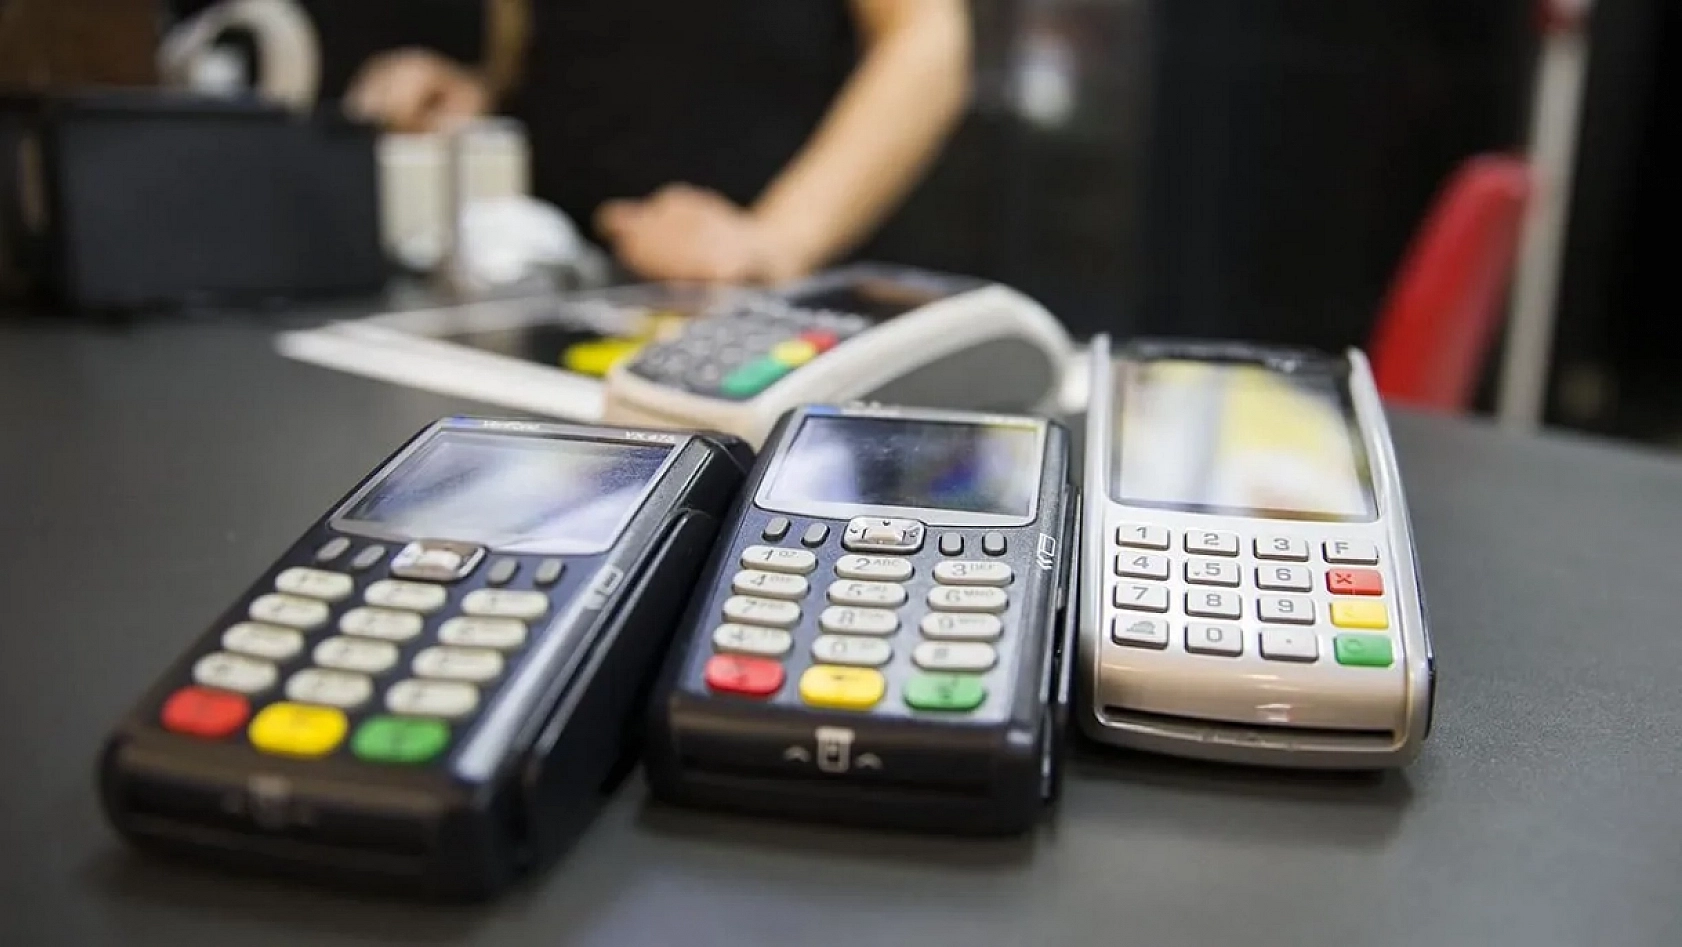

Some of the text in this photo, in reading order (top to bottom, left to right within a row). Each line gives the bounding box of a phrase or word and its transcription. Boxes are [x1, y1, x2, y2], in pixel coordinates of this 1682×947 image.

[1136, 526, 1147, 539] 1
[1203, 532, 1220, 546] 2
[1273, 537, 1290, 551] 3
[1334, 541, 1349, 554] F
[763, 549, 774, 561] 1
[855, 558, 871, 570] 2
[1133, 555, 1150, 569] 4
[952, 563, 967, 576] 3
[1205, 562, 1221, 576] 5
[1276, 568, 1292, 581] 6
[750, 574, 767, 586] 4
[945, 589, 961, 602] 6
[1131, 586, 1149, 600] 7
[1206, 594, 1222, 607] 8
[1278, 600, 1294, 613] 9
[1206, 627, 1222, 642] 0
